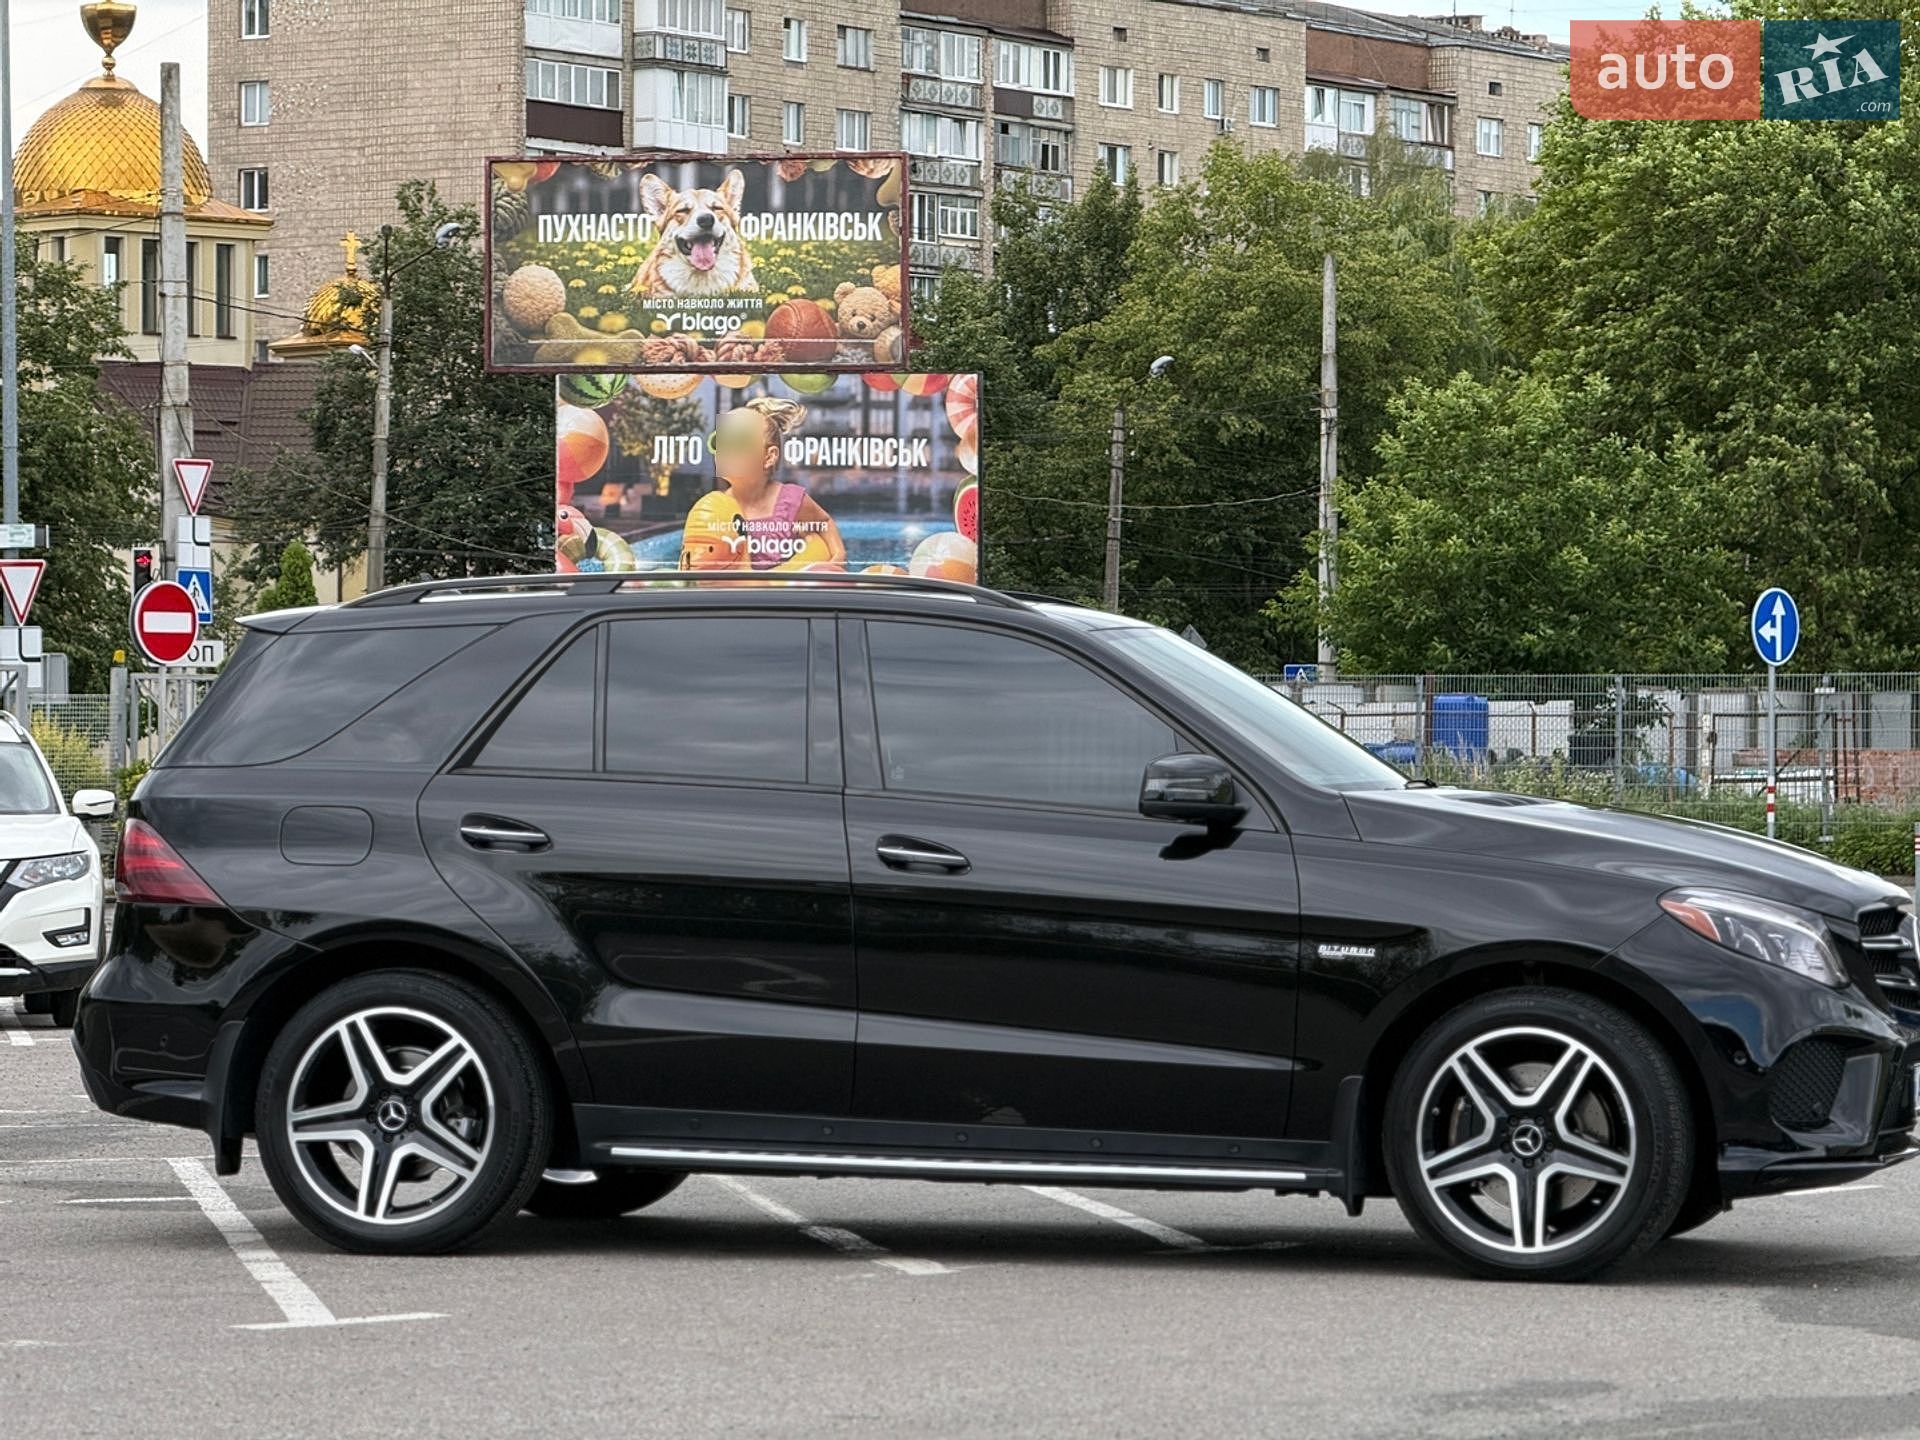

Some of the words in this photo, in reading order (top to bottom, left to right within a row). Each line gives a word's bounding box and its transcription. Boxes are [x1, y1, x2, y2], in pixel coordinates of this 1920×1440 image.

[538, 212, 653, 243] ПУХНАСТО
[739, 211, 884, 242] ФРАНКІВСЬК
[650, 435, 702, 465] ЛІТО
[783, 437, 928, 467] ФРАНКІВСЬК
[747, 535, 807, 559] blago
